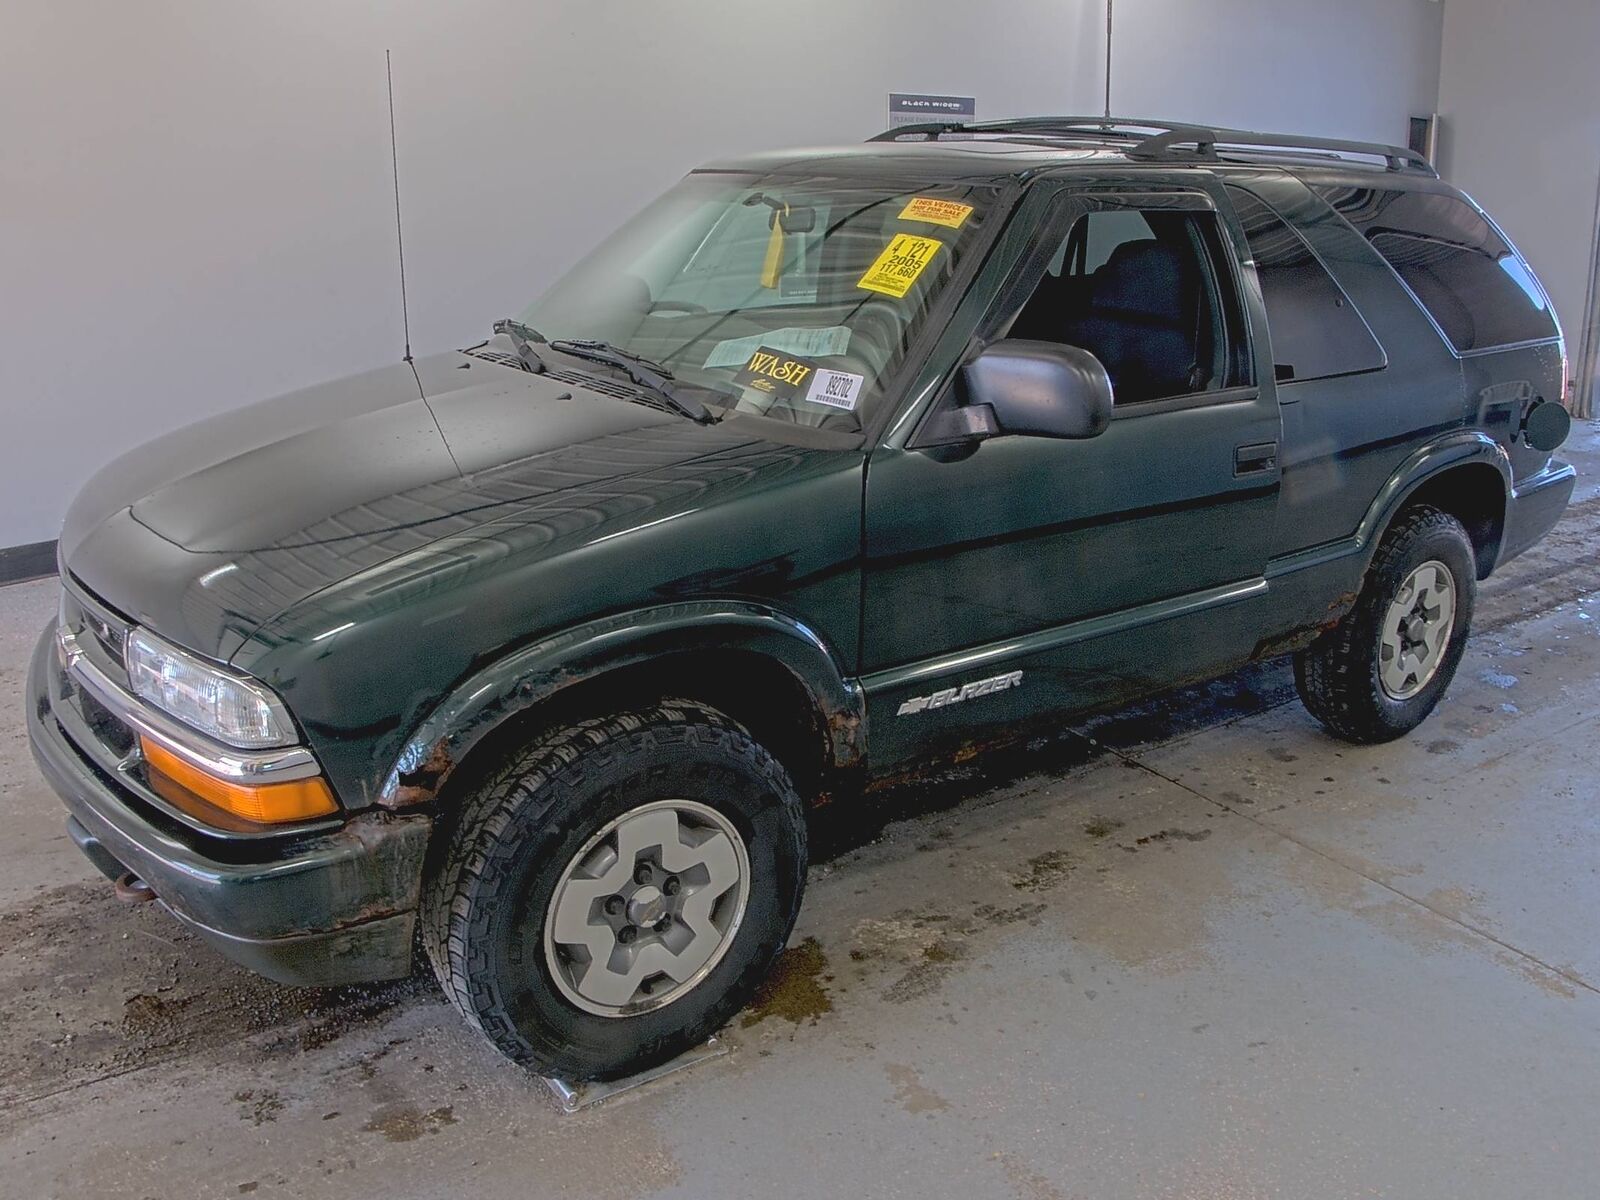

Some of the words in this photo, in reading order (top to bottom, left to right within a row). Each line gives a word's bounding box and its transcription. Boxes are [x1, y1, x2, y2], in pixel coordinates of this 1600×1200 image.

[934, 201, 969, 212] VEHICLE
[892, 239, 906, 254] 4
[906, 240, 931, 260] 121
[889, 254, 924, 270] 2005
[747, 352, 811, 386] WASH
[927, 669, 1023, 710] BLAZER
